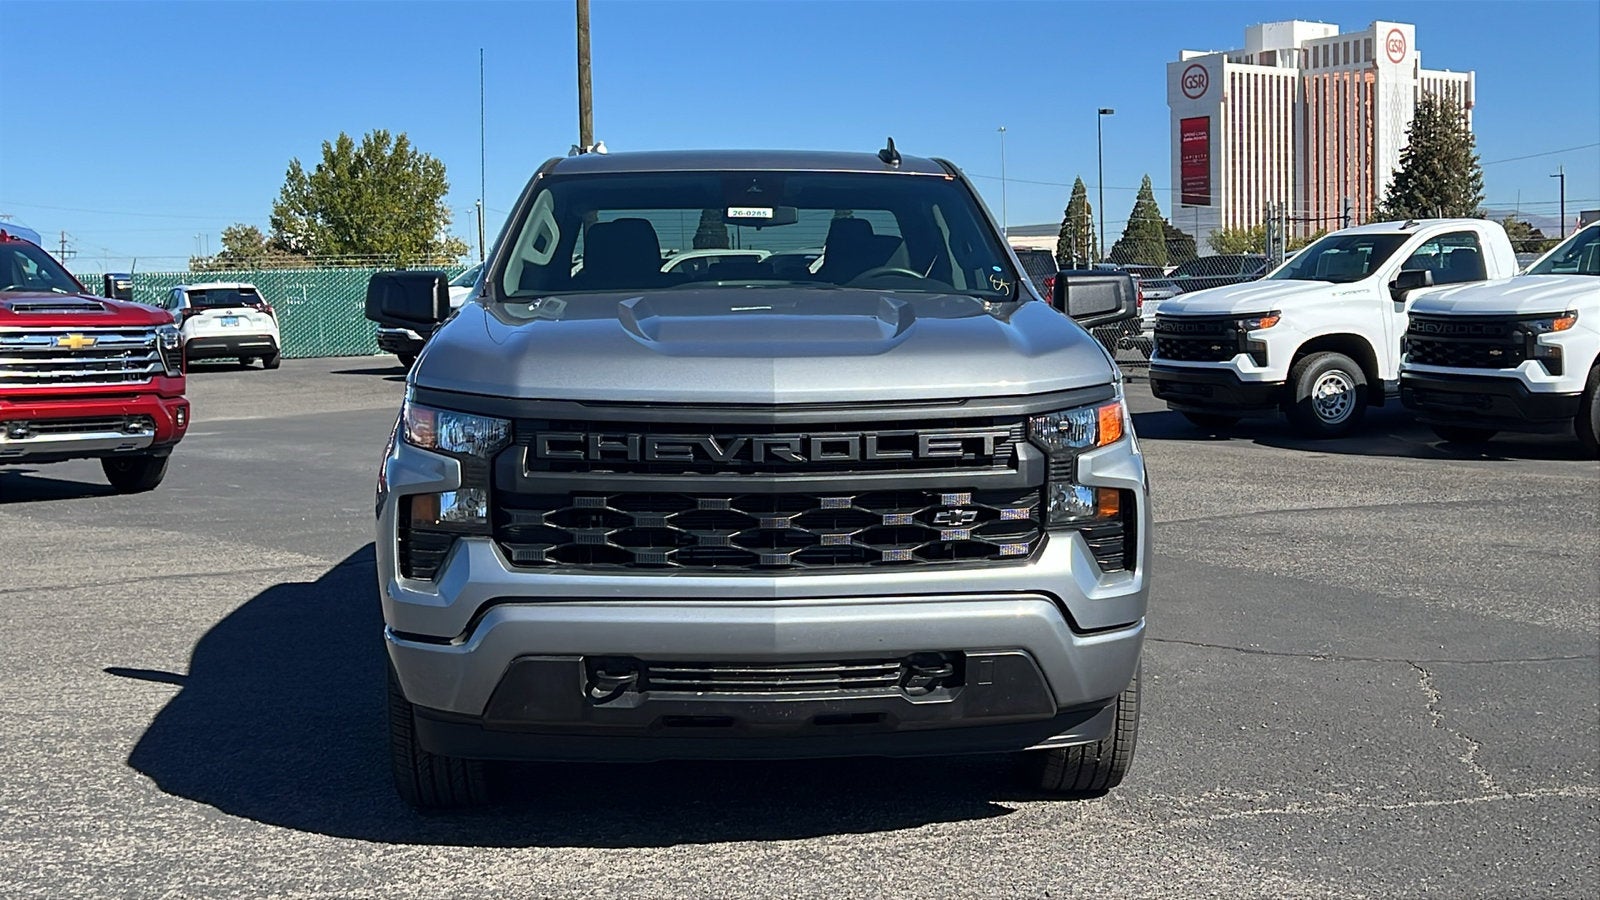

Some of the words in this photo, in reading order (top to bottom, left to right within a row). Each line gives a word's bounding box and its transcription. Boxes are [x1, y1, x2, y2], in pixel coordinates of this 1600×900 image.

[1389, 39, 1404, 53] GSR
[1185, 74, 1205, 89] GSR
[535, 430, 1011, 463] CHEVROLET
